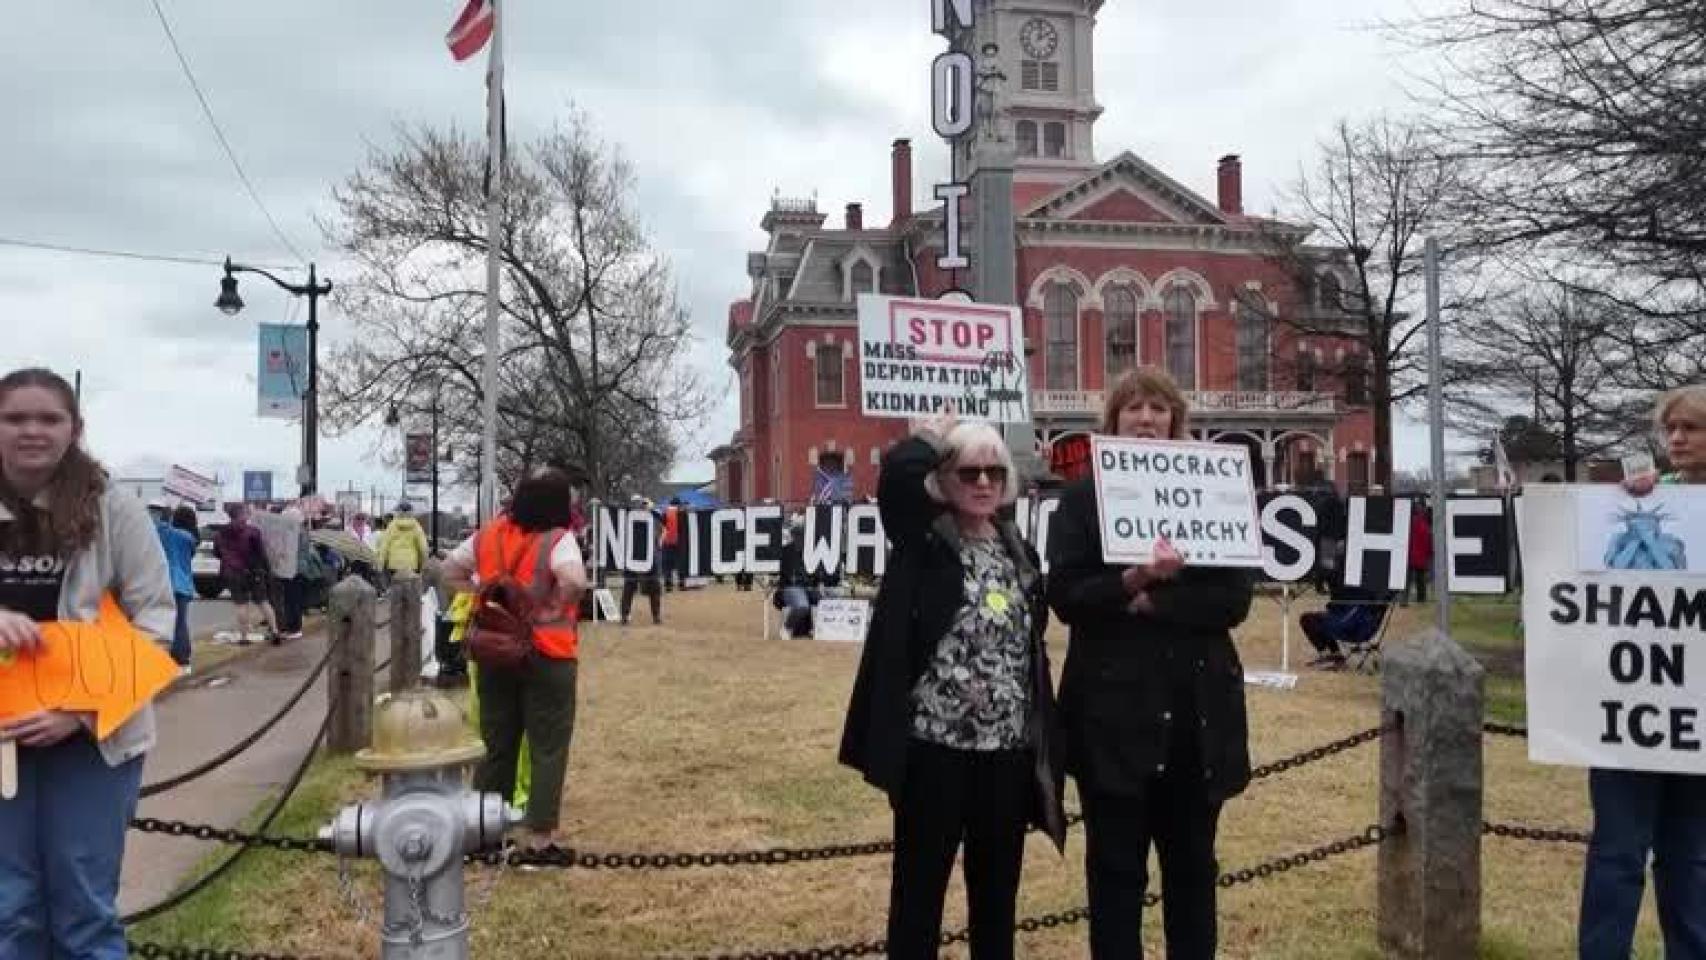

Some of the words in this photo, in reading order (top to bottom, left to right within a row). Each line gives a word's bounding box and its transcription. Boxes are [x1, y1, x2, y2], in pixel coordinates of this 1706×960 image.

[908, 317, 995, 350] STOP
[863, 339, 917, 361] MASS
[864, 361, 993, 388] DEPORTATION
[1101, 450, 1245, 477] DEMOCRACY
[1154, 486, 1204, 508] NOT
[598, 506, 655, 572] NO
[688, 505, 781, 577] ICE
[1114, 517, 1249, 542] OLIGARCHY
[1609, 639, 1686, 688] ON
[1600, 700, 1702, 751] ICE
